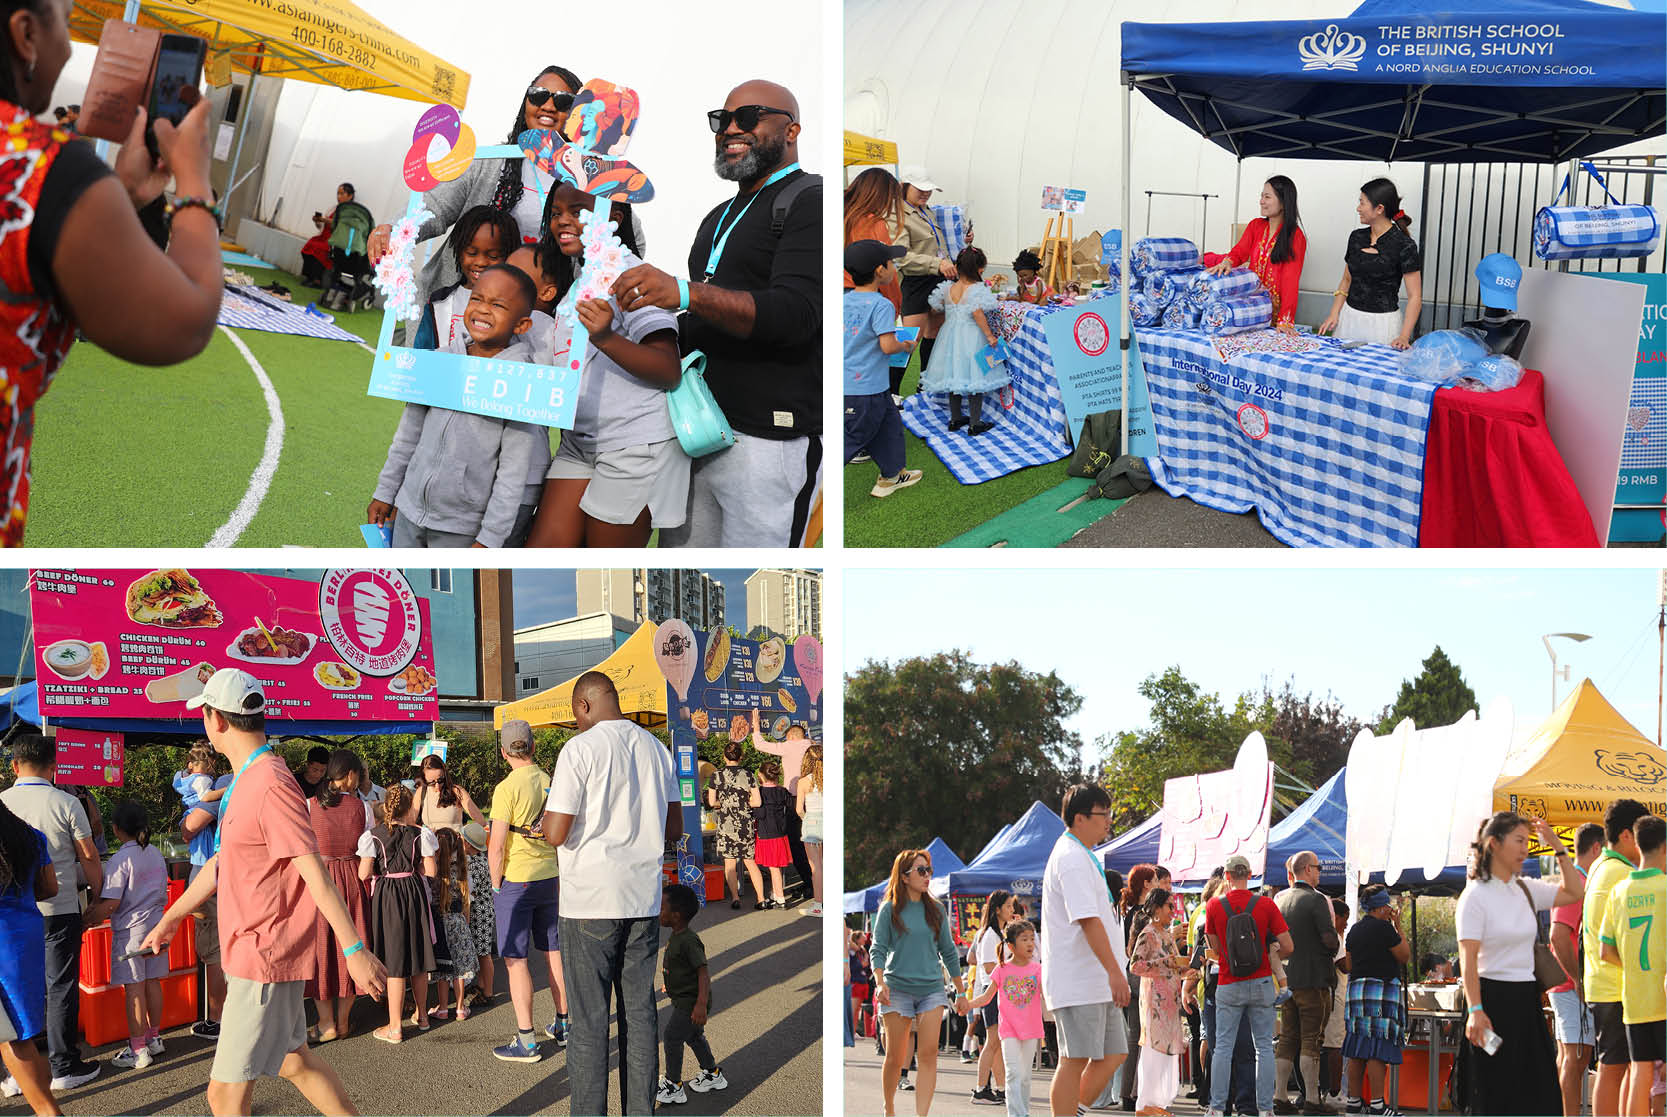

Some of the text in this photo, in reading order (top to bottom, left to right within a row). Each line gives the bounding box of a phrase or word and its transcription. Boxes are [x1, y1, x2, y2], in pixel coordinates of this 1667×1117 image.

[1378, 24, 1564, 40] THE BRITISH SCHOOL
[292, 26, 376, 71] 400-168-2882
[1377, 42, 1553, 58] OF BEIJING, SHUNYI
[1376, 64, 1596, 75] A NORD ANGLIA EDUCATION SCHOOL
[1495, 276, 1516, 288] BSB
[1481, 361, 1496, 372] SB
[1172, 359, 1282, 400] International Day 2024
[1631, 475, 1657, 485] RMB
[37, 570, 61, 580] BEEF
[64, 573, 98, 584] DÖNER
[120, 634, 159, 643] CHICKEN
[161, 636, 191, 645] DÜRÜM
[330, 622, 366, 665] 柏林百特
[146, 656, 176, 665] DÜRÜM
[369, 638, 412, 669] 地道烤肉堡
[44, 684, 88, 693] TZATZIKI
[97, 686, 128, 694] BREAD
[1629, 915, 1653, 971] 7
